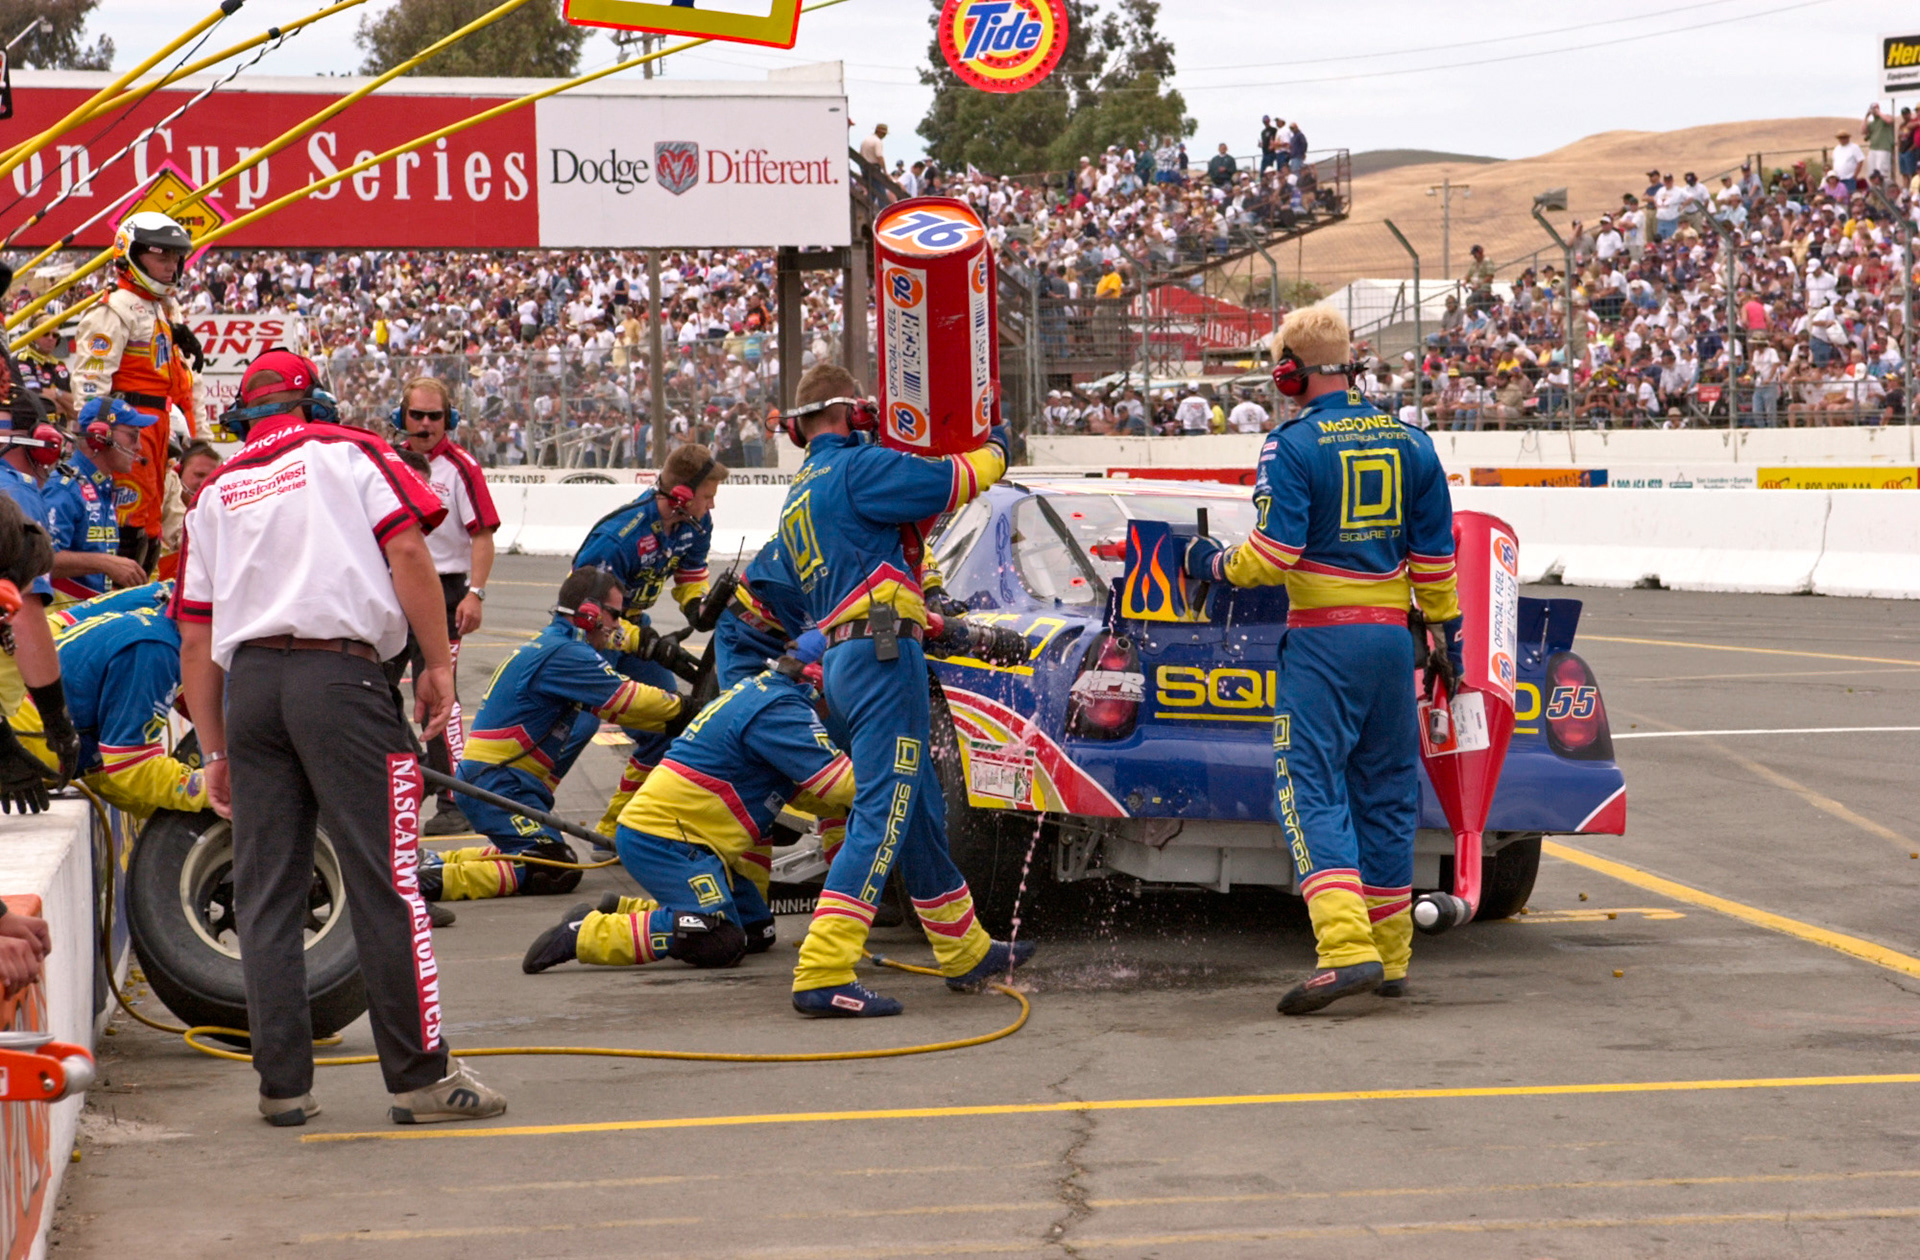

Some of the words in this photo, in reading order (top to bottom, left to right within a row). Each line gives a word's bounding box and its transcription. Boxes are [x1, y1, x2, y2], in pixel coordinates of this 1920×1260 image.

[960, 1, 1044, 62] Tide
[134, 127, 270, 210] Cup
[308, 132, 529, 202] Series
[550, 149, 650, 195] Dodge
[706, 149, 839, 185] Different.
[879, 210, 983, 250] 76
[892, 273, 914, 304] 76
[184, 320, 284, 337] ARS
[888, 308, 897, 340] FUEL
[889, 343, 898, 397] OFFICIAL
[895, 407, 917, 437] 76
[276, 479, 307, 496] Series
[1340, 529, 1387, 542] SQUARE
[1494, 570, 1504, 598] FUEL
[1494, 600, 1503, 649] OFFICIAL
[1545, 685, 1597, 719] 55
[874, 783, 911, 878] SQUARE
[1278, 786, 1310, 876] SQUARE
[862, 883, 879, 904] D
